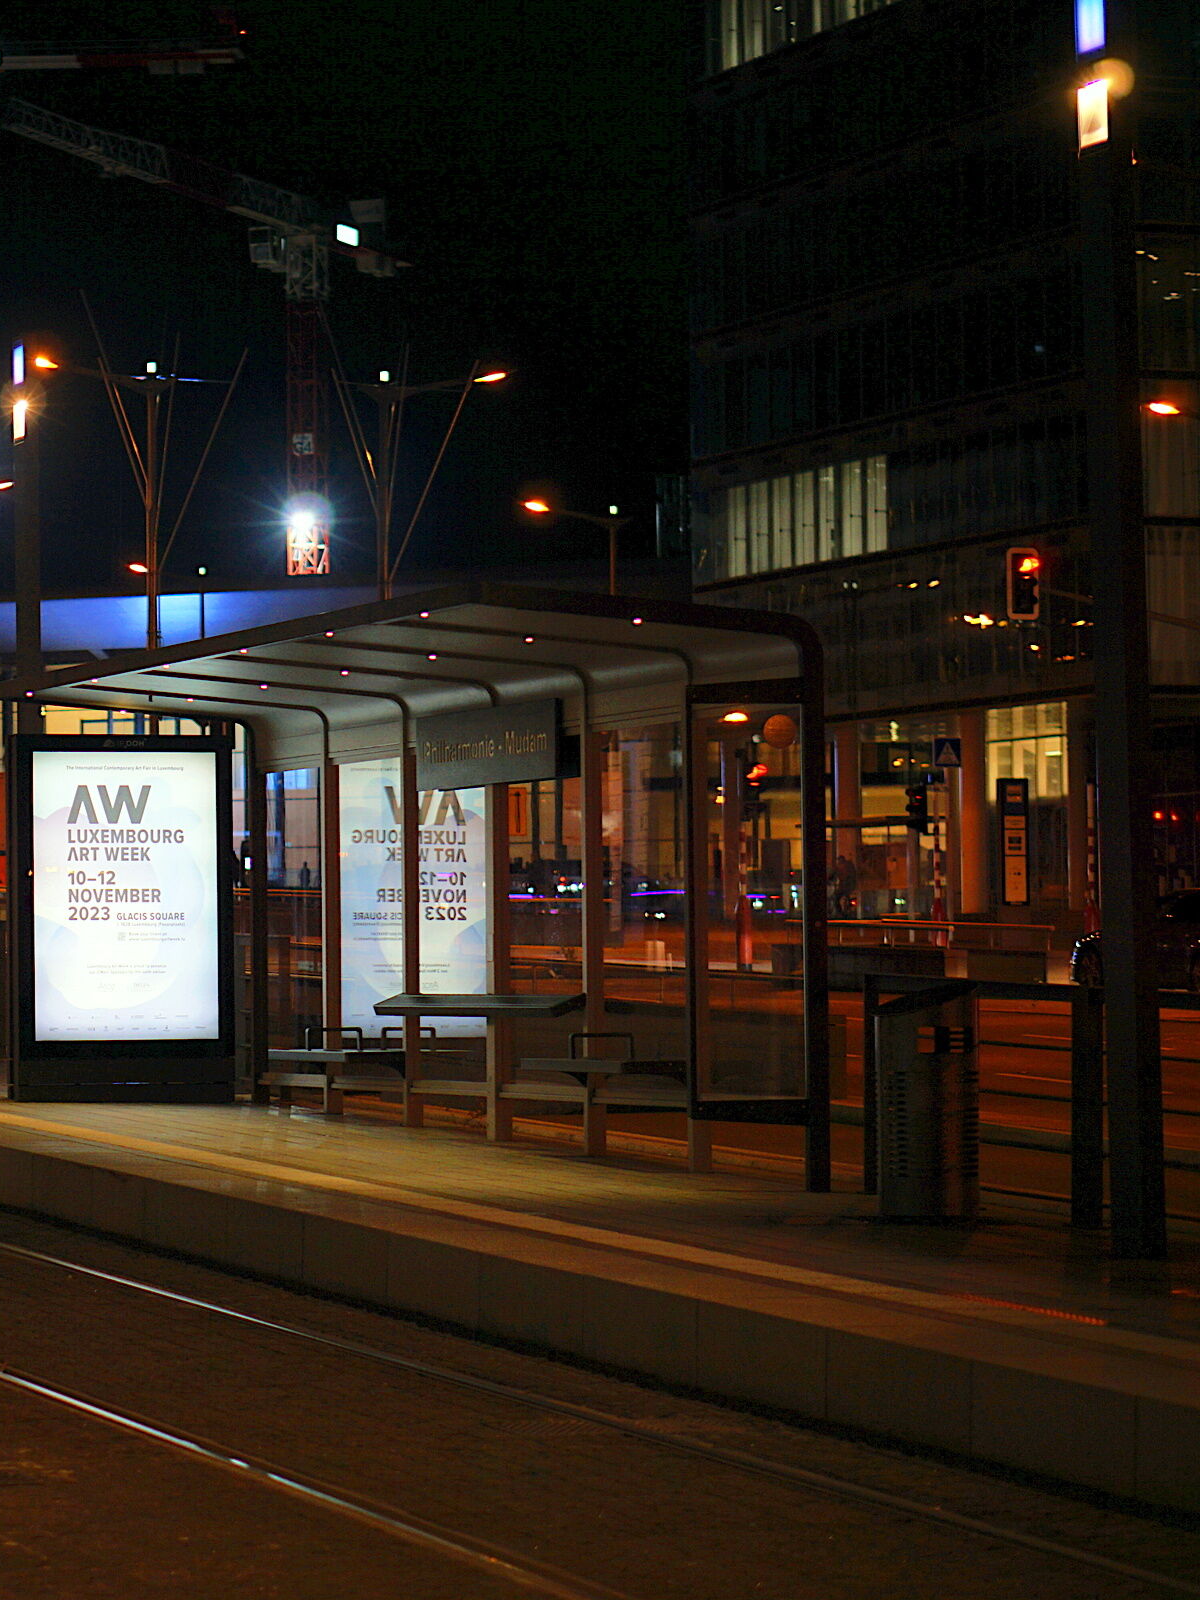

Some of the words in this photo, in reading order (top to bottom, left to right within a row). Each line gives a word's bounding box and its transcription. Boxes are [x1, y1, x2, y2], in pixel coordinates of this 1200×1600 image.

[422, 735, 496, 763] Philharmonie
[504, 729, 548, 755] Mudam
[67, 829, 185, 844] LUXEMBOURG
[67, 847, 100, 862] ART
[104, 847, 151, 862] WEEK
[68, 888, 161, 903] NOVEMBER
[68, 906, 111, 921] 2023
[116, 912, 148, 921] GLACIS
[149, 912, 185, 921] SQUARE
